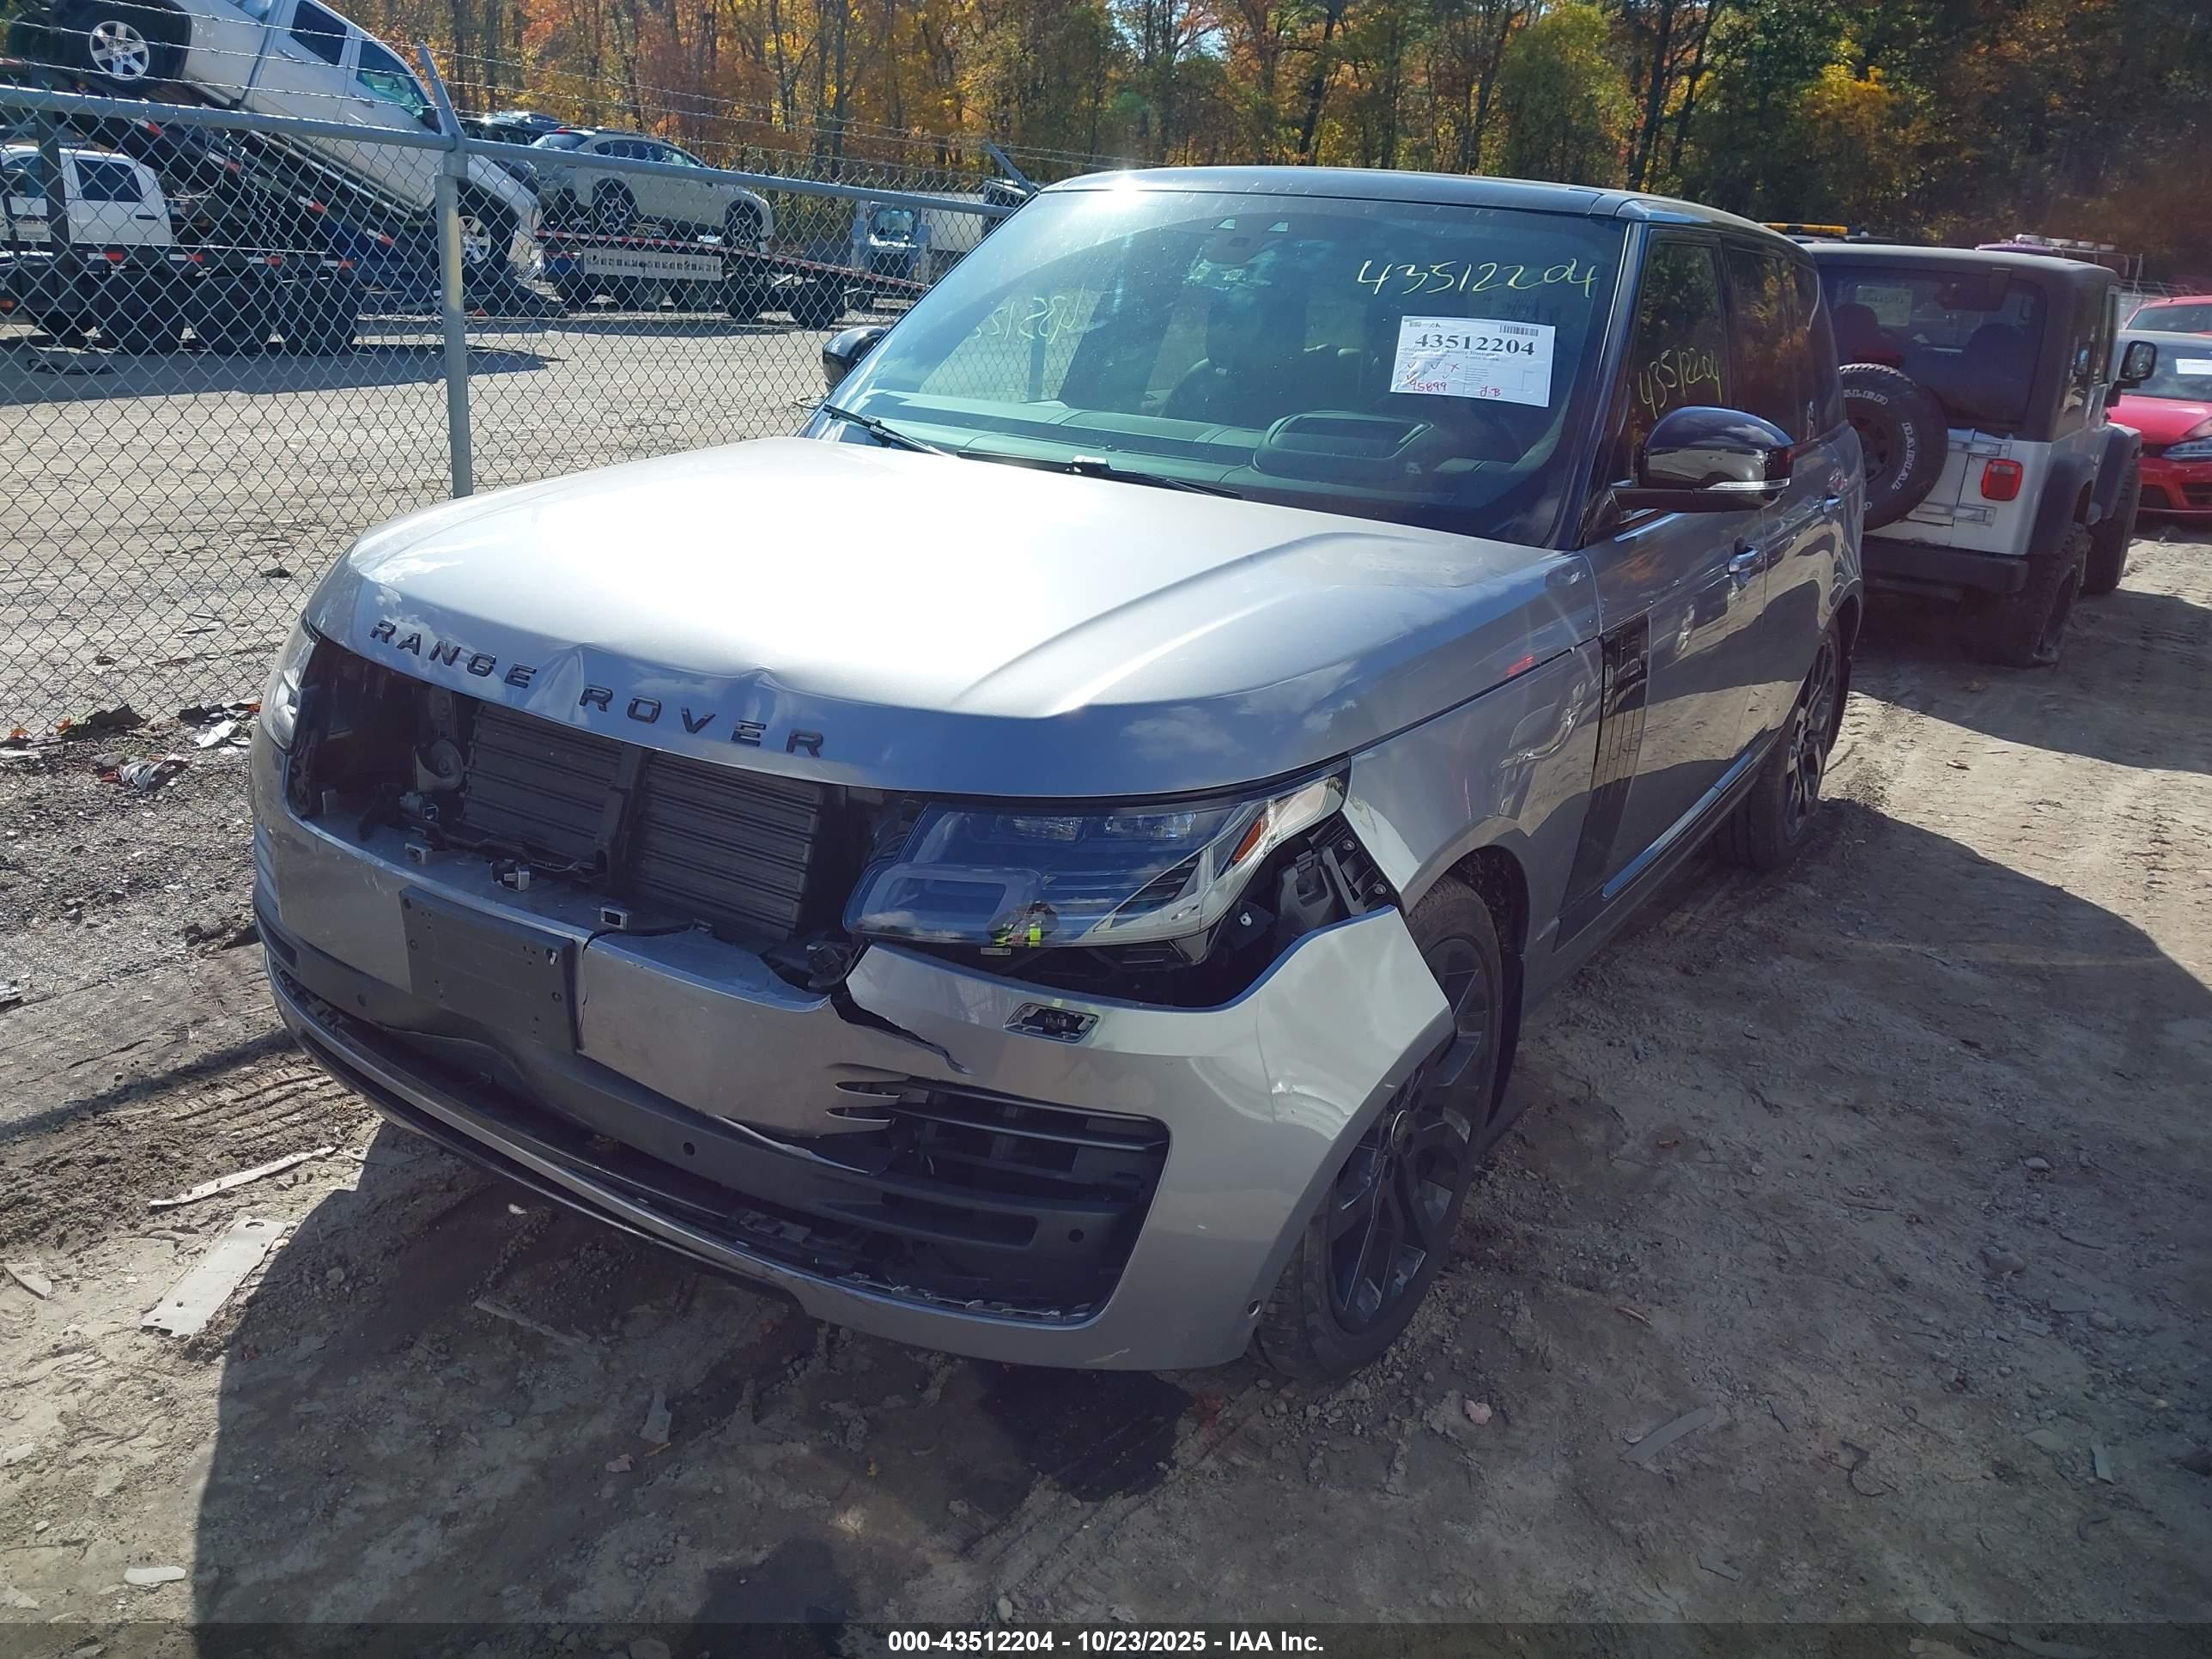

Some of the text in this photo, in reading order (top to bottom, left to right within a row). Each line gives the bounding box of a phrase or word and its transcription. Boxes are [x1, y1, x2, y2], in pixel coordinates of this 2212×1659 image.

[1357, 258, 1597, 299] 43512204
[1414, 333, 1535, 356] 43512204
[1638, 347, 1723, 420] 43512204
[1891, 421, 1917, 491] RADIAL
[369, 619, 825, 757] RANGE ROVER
